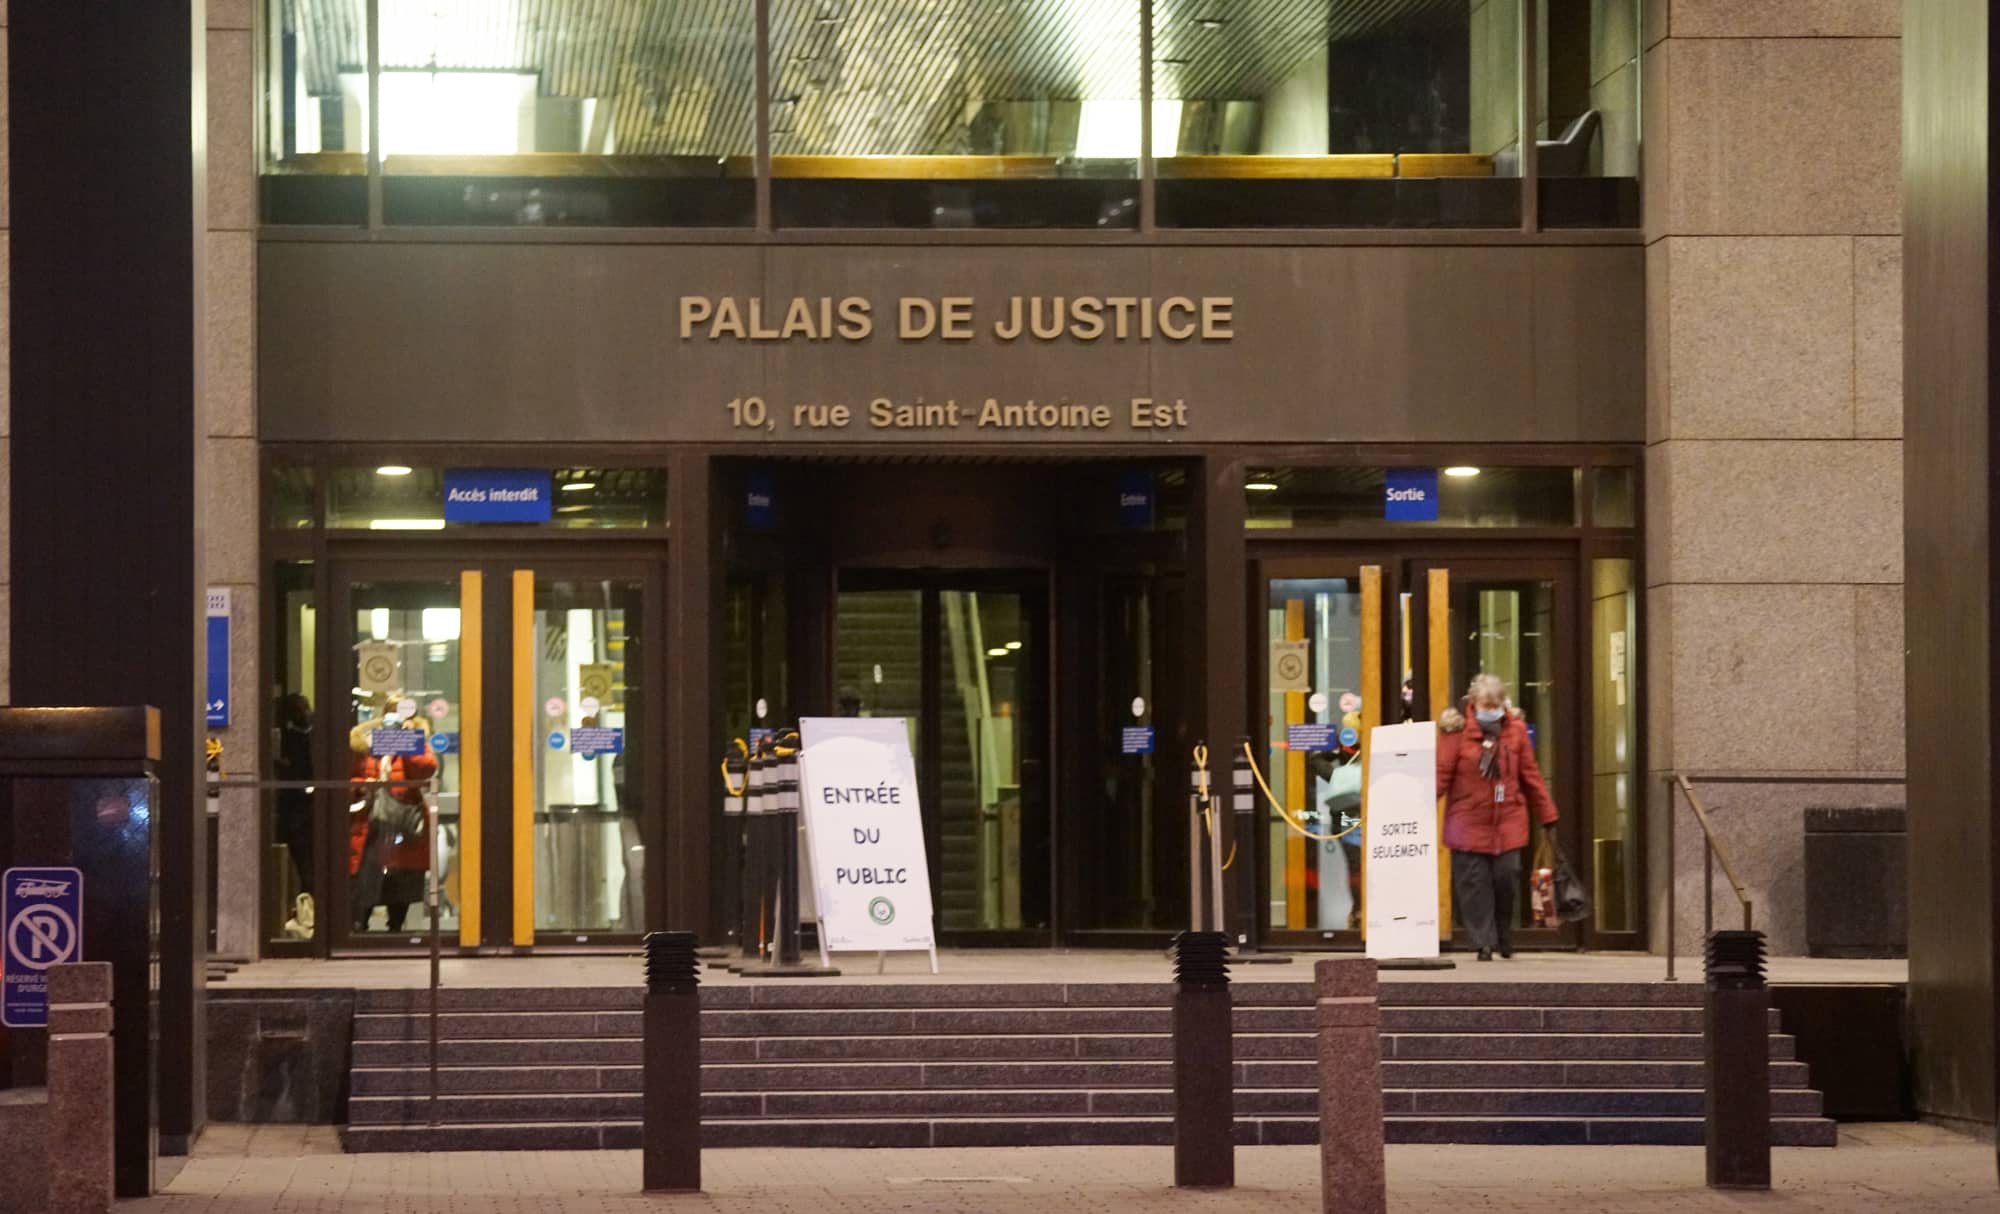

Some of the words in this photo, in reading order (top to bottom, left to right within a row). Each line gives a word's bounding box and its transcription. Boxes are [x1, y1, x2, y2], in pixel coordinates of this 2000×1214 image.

[679, 296, 873, 340] PALAIS
[900, 297, 974, 340] DE
[994, 296, 1235, 340] JUSTICE
[727, 398, 776, 431] 10,
[794, 404, 850, 427] rue
[869, 397, 1111, 428] Saint-Antoine
[1130, 398, 1188, 427] Est
[448, 488, 486, 502] Accès
[489, 488, 539, 502] interdit
[1386, 488, 1425, 502] Sortie
[823, 781, 901, 804] ENTRÉE
[853, 828, 880, 845] DU
[1382, 821, 1418, 836] SORTIE
[1373, 843, 1430, 859] SEULEMENT
[837, 868, 907, 884] PUBLIC
